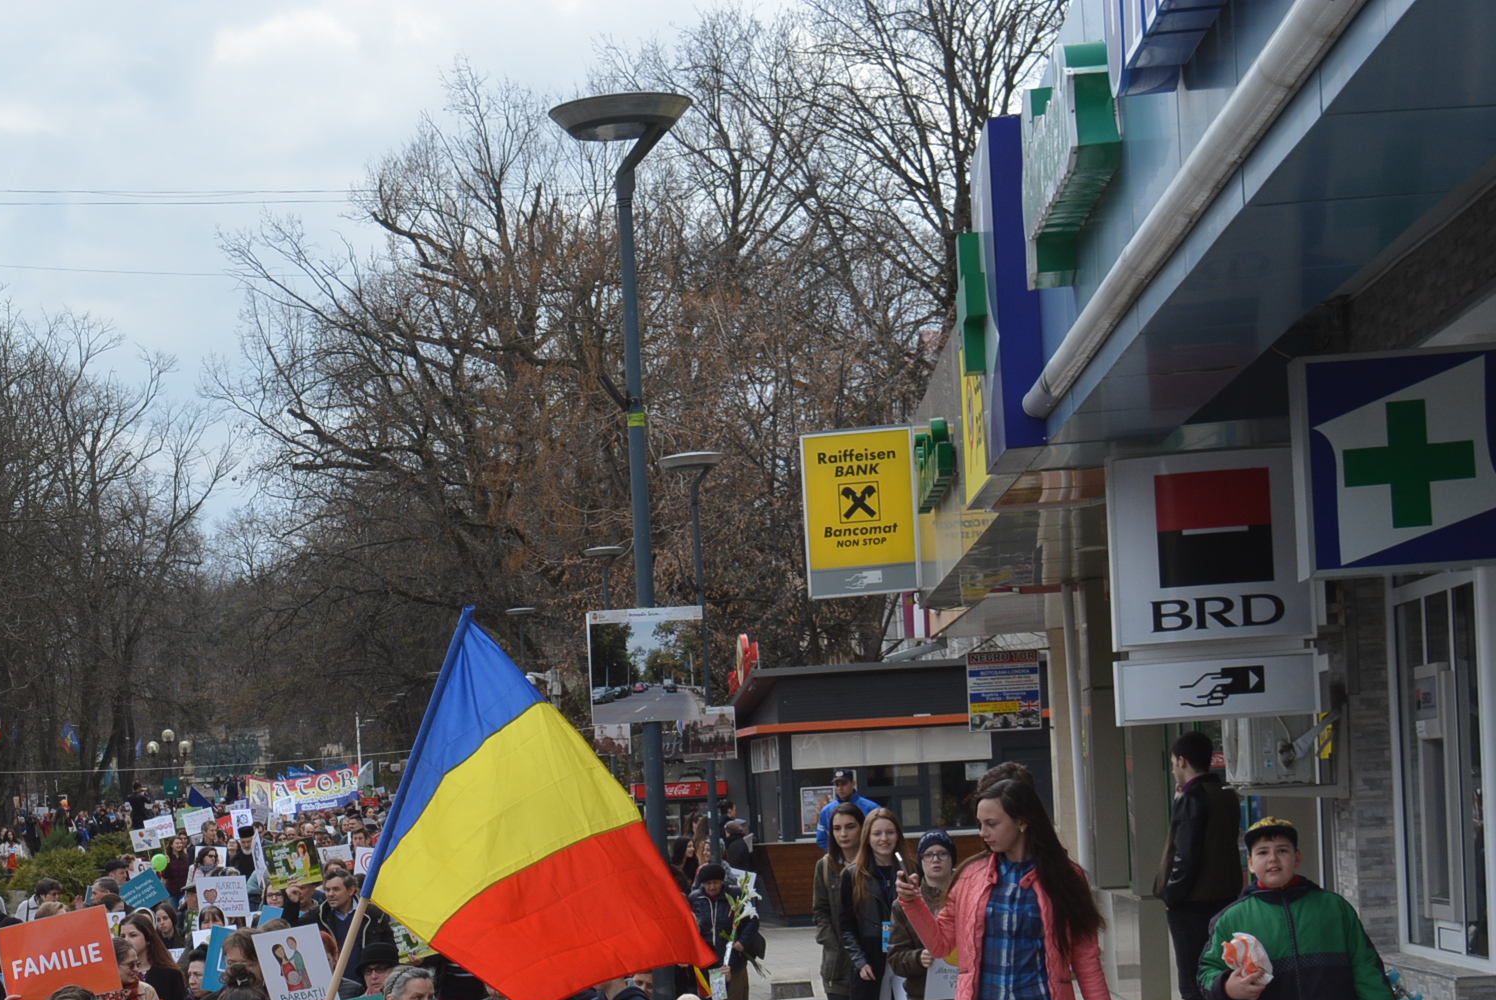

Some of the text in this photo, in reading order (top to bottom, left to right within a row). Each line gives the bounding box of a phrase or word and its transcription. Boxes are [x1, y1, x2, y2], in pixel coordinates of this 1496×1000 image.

[817, 448, 896, 465] Raiffeisen
[834, 462, 880, 478] BANK
[824, 522, 898, 538] Bancomat
[836, 536, 887, 549] NON STOP
[1149, 593, 1285, 634] BRD
[970, 651, 1035, 663] NEGRU TUR
[11, 941, 104, 980] FAMILIE
